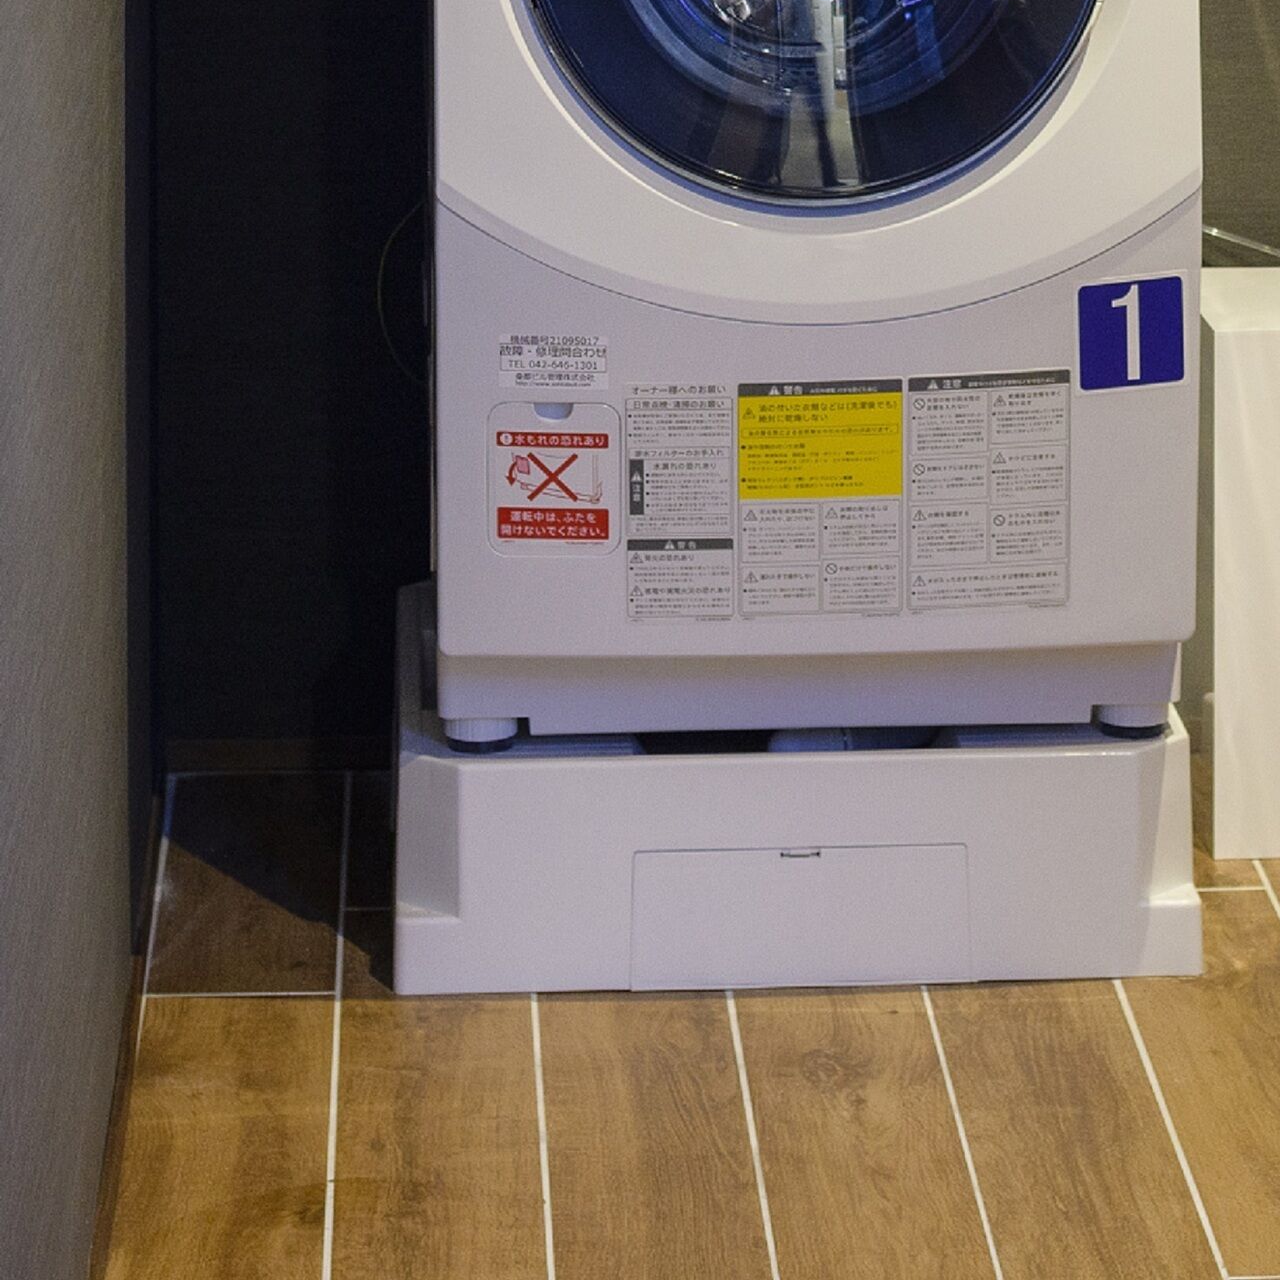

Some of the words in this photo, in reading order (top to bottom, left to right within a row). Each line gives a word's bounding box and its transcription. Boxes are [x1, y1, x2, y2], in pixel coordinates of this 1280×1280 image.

[1112, 283, 1142, 381] 1
[510, 335, 599, 346] 機械番号21095017
[500, 345, 607, 358] 故障・修理問合わせ
[508, 360, 526, 368] TEL
[528, 360, 598, 370] 042-646-1301
[632, 384, 726, 395] オーナー様へのお願い
[942, 379, 963, 389] 注意
[783, 385, 803, 396] 警告
[514, 435, 604, 446] 水もれの恐れあり
[510, 511, 597, 523] 運転中は、ふたを
[501, 525, 606, 537] 開けないでください。
